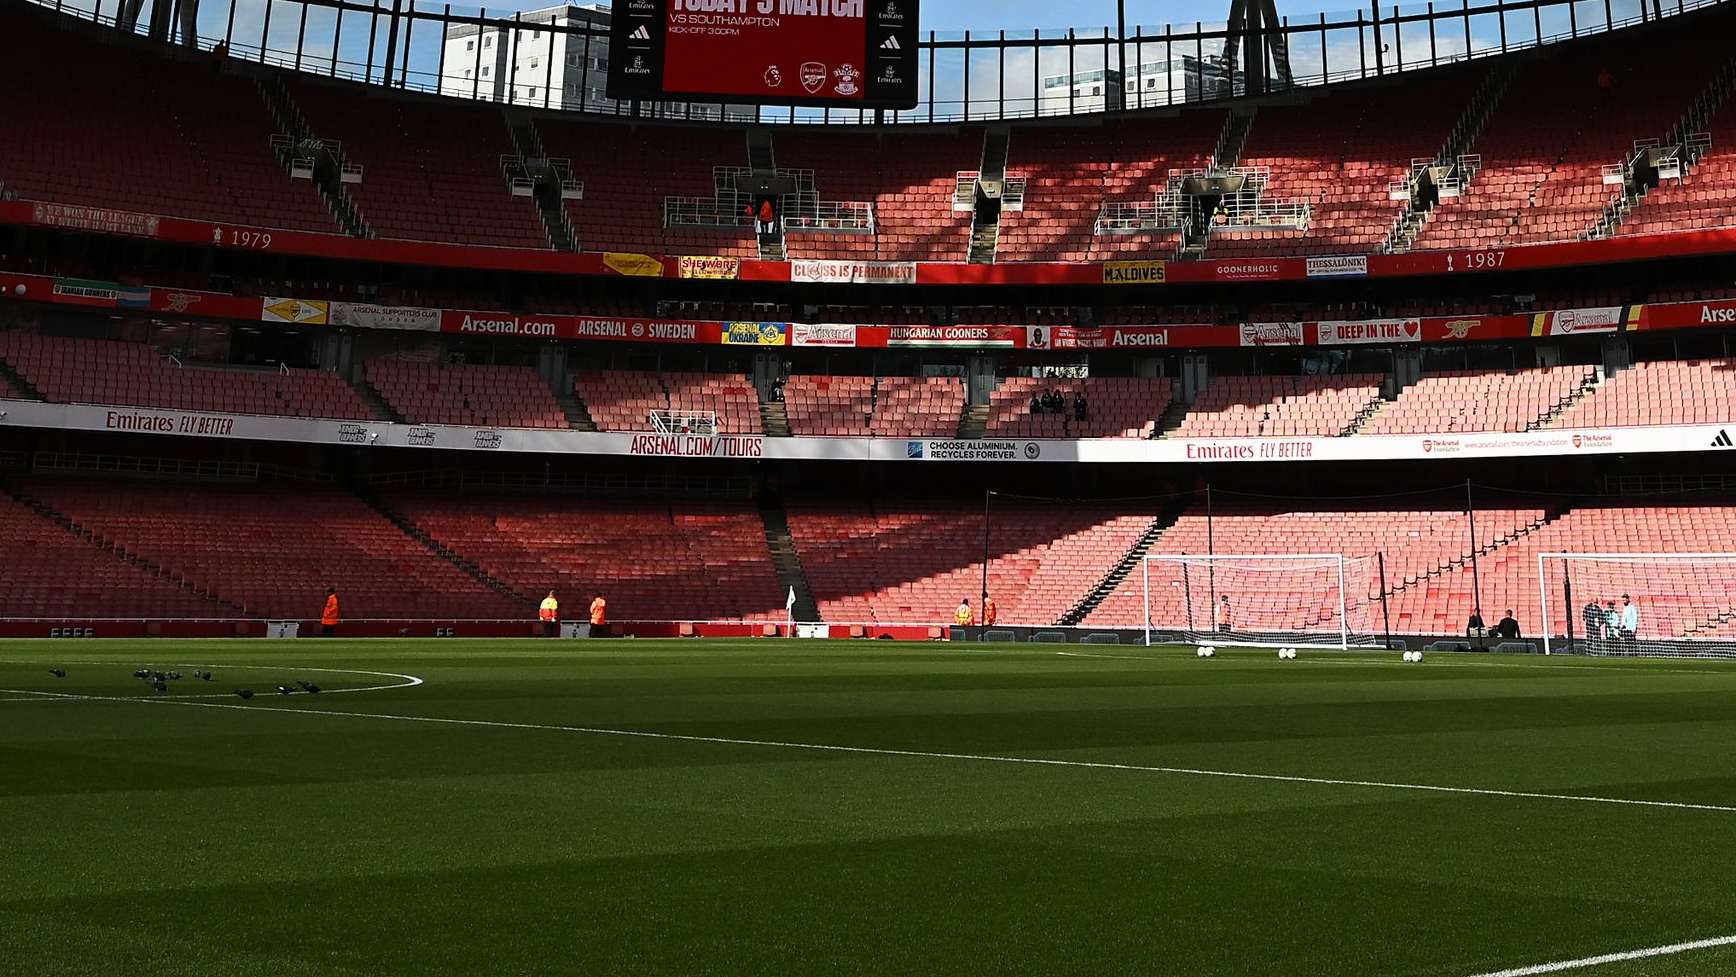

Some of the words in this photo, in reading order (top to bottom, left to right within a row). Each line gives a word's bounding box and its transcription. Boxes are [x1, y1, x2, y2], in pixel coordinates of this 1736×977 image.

[669, 14, 688, 24] VS
[688, 15, 780, 27] SOUTHAMPTON
[668, 26, 707, 35] KICK-OFF
[231, 230, 272, 249] 1979
[682, 259, 703, 268] SHE
[706, 259, 737, 269] WORE
[1465, 252, 1506, 268] 1987
[794, 264, 837, 278] CLSS
[839, 264, 850, 277] IS
[852, 265, 914, 279] PERMANENT
[1104, 267, 1165, 281] MALDIVES
[1217, 265, 1279, 274] GOONERHOLIC
[1575, 310, 1614, 325] Arsenal
[460, 315, 556, 336] Arsenal.com
[578, 320, 627, 338] ARSENAL
[648, 323, 697, 340] SWEDEN
[728, 323, 760, 334] ARSENAL
[808, 325, 855, 340] Arsenal
[890, 327, 943, 339] HUNGARIAN
[945, 327, 989, 339] GOONERS
[1257, 325, 1301, 338] Arsenal
[1337, 324, 1364, 340] DEEP
[1365, 324, 1378, 339] IN
[1379, 323, 1401, 338] THE
[728, 332, 759, 344] UKRAINE
[1112, 329, 1169, 346] Arsenal
[106, 411, 174, 432] Emirates
[179, 415, 196, 433] FLY
[198, 417, 234, 435] BETTER
[630, 435, 763, 457] ARSENAL.COM/TOURS
[929, 441, 965, 450] CHOOSE
[966, 441, 1018, 451] ALUMINIUM.
[1186, 442, 1255, 459] Emirates
[1260, 441, 1276, 458] FLY
[1278, 441, 1313, 458] BETTER
[931, 450, 974, 459] RECYCLES
[975, 450, 1017, 460] FOREVER.
